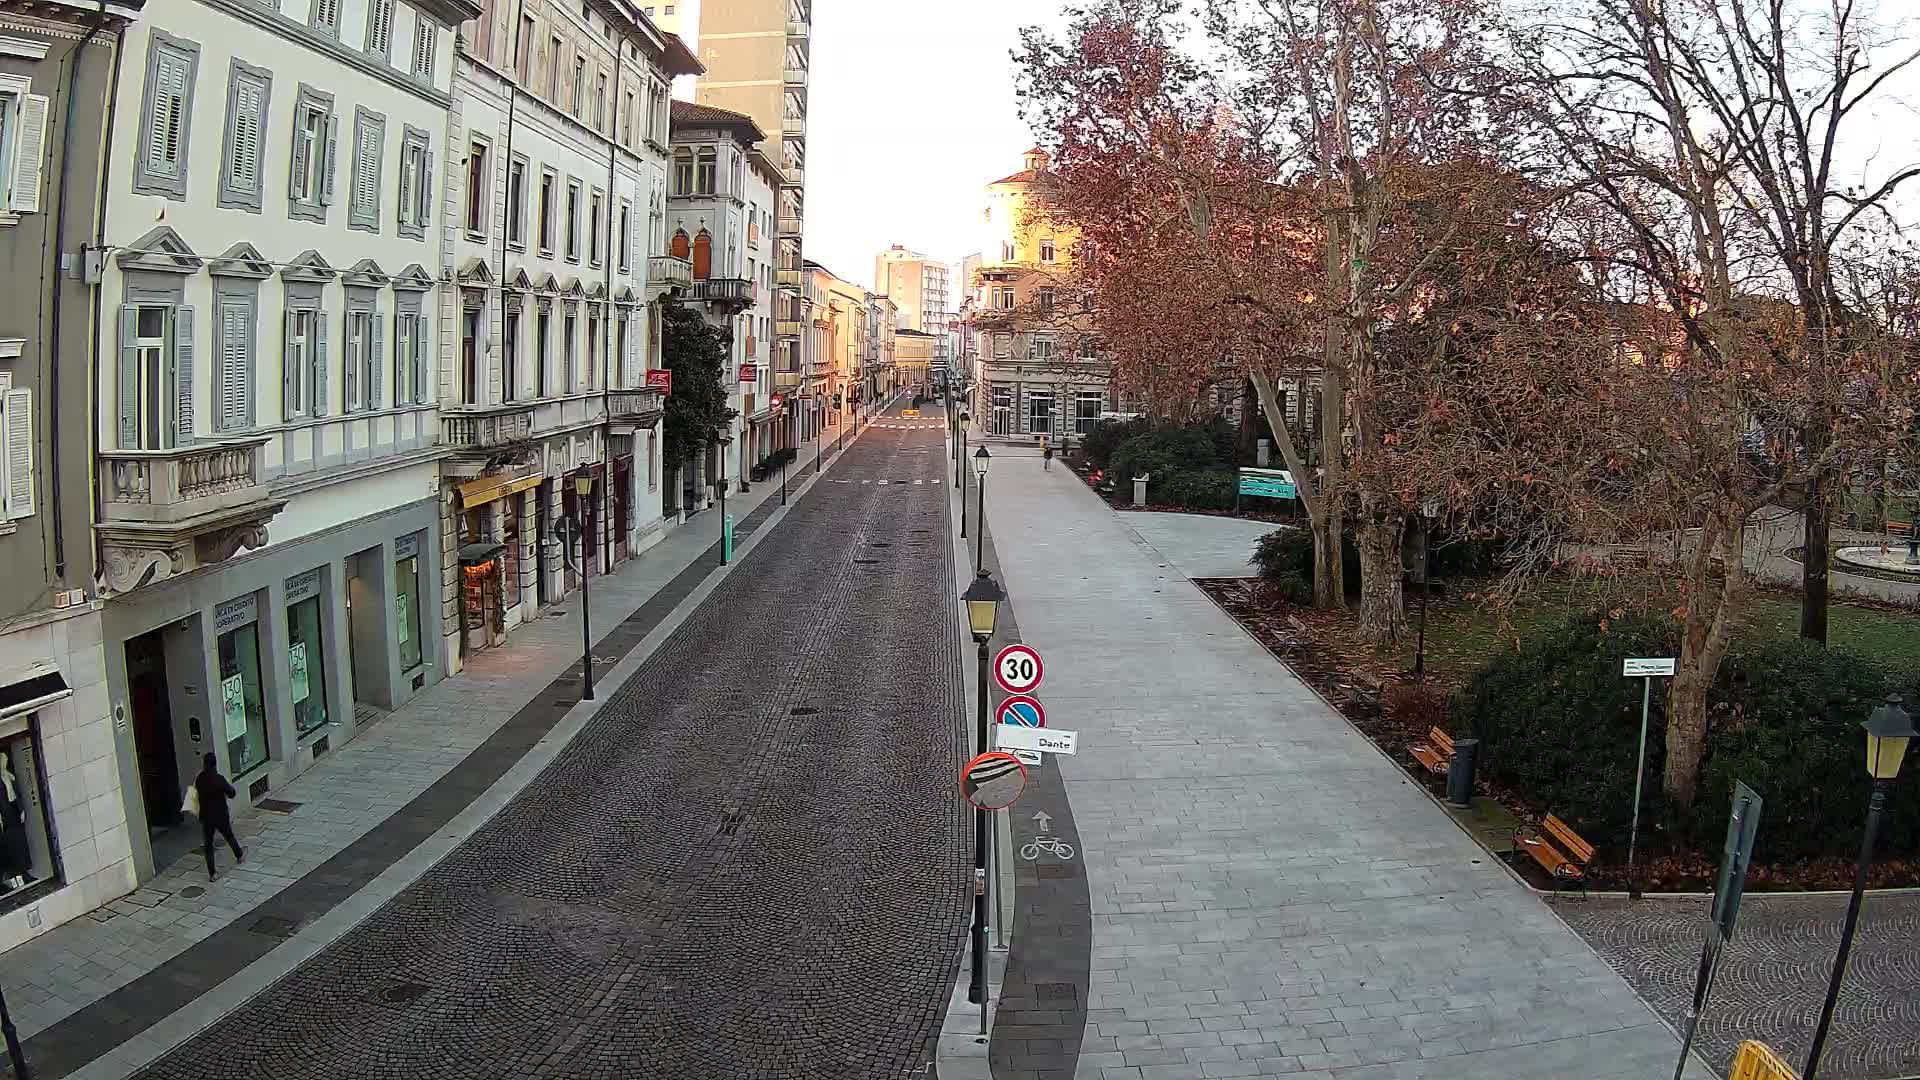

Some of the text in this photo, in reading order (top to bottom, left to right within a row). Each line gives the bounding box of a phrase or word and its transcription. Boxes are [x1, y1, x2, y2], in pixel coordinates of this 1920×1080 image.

[1006, 658, 1033, 680] 30
[222, 677, 241, 701] 130
[1039, 738, 1070, 749] Dante
